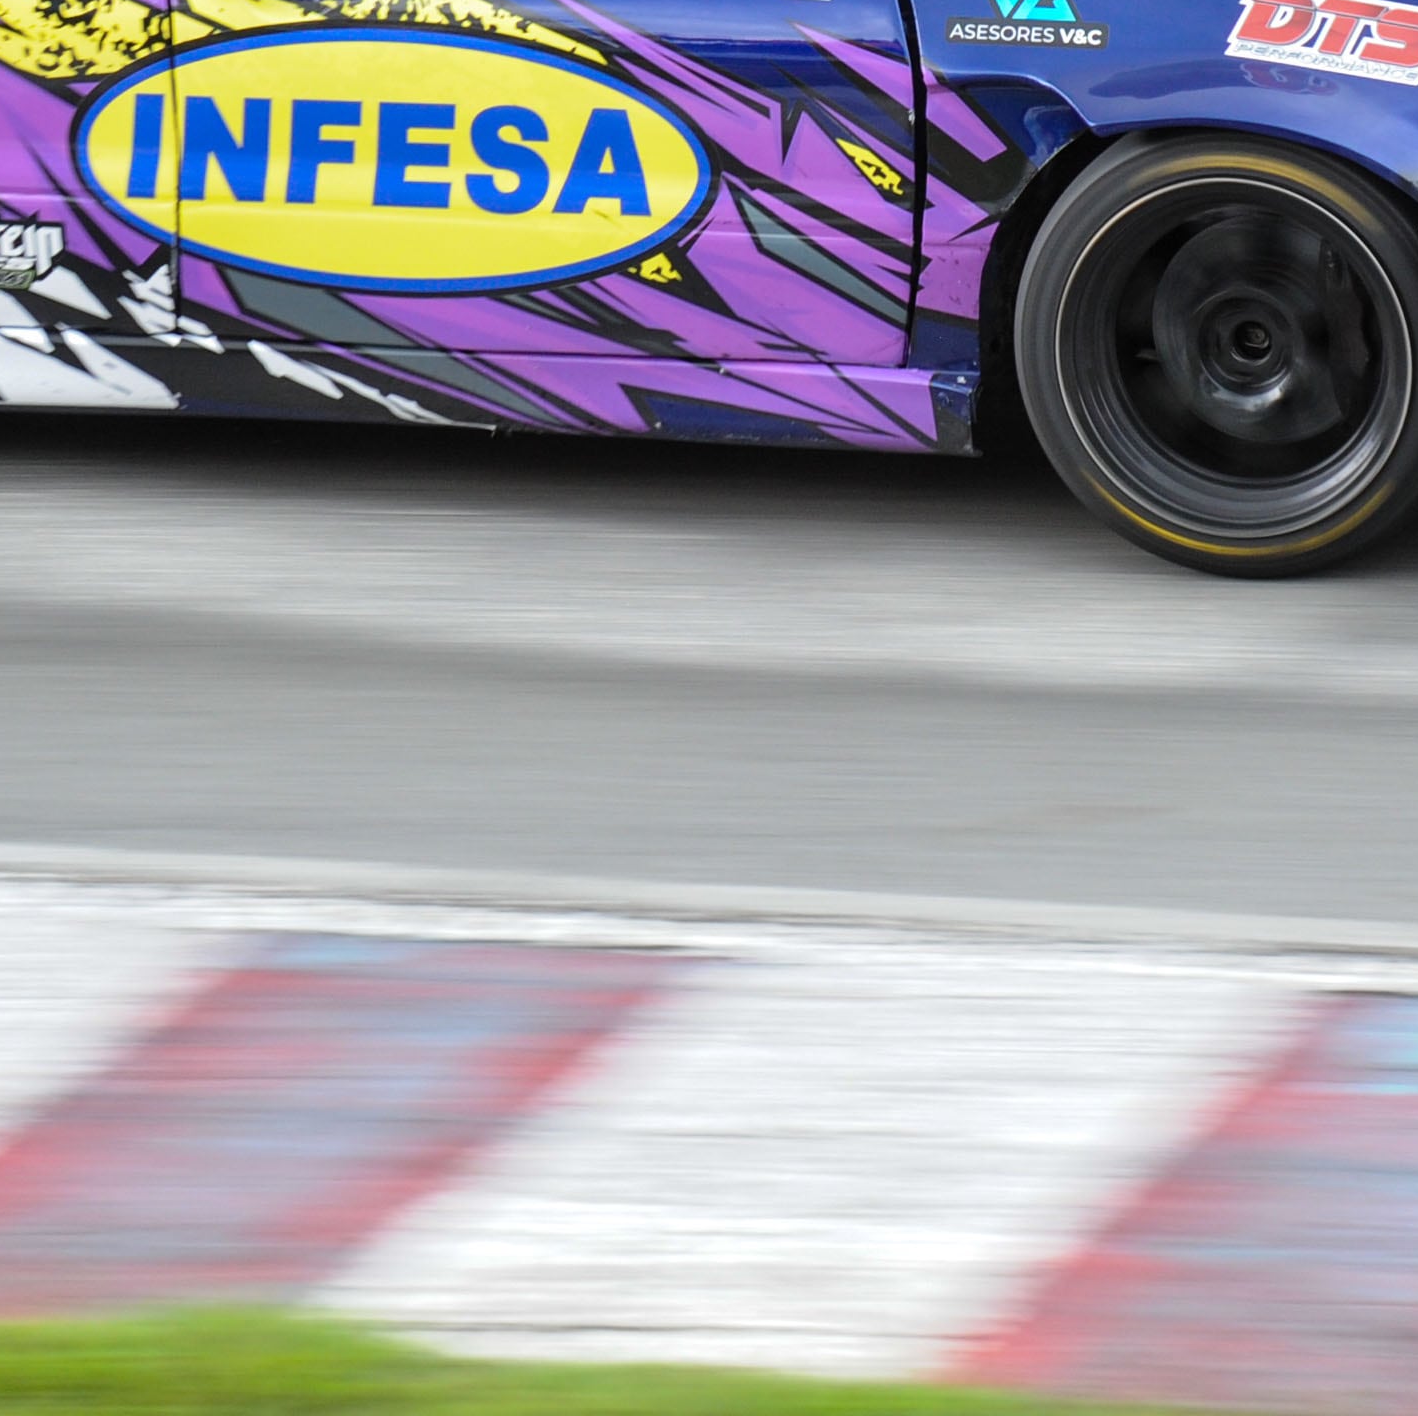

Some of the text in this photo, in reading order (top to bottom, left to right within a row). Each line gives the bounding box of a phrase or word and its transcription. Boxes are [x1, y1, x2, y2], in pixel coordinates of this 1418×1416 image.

[949, 23, 1103, 46] ASESORES V&C
[125, 92, 653, 218] INFESA
